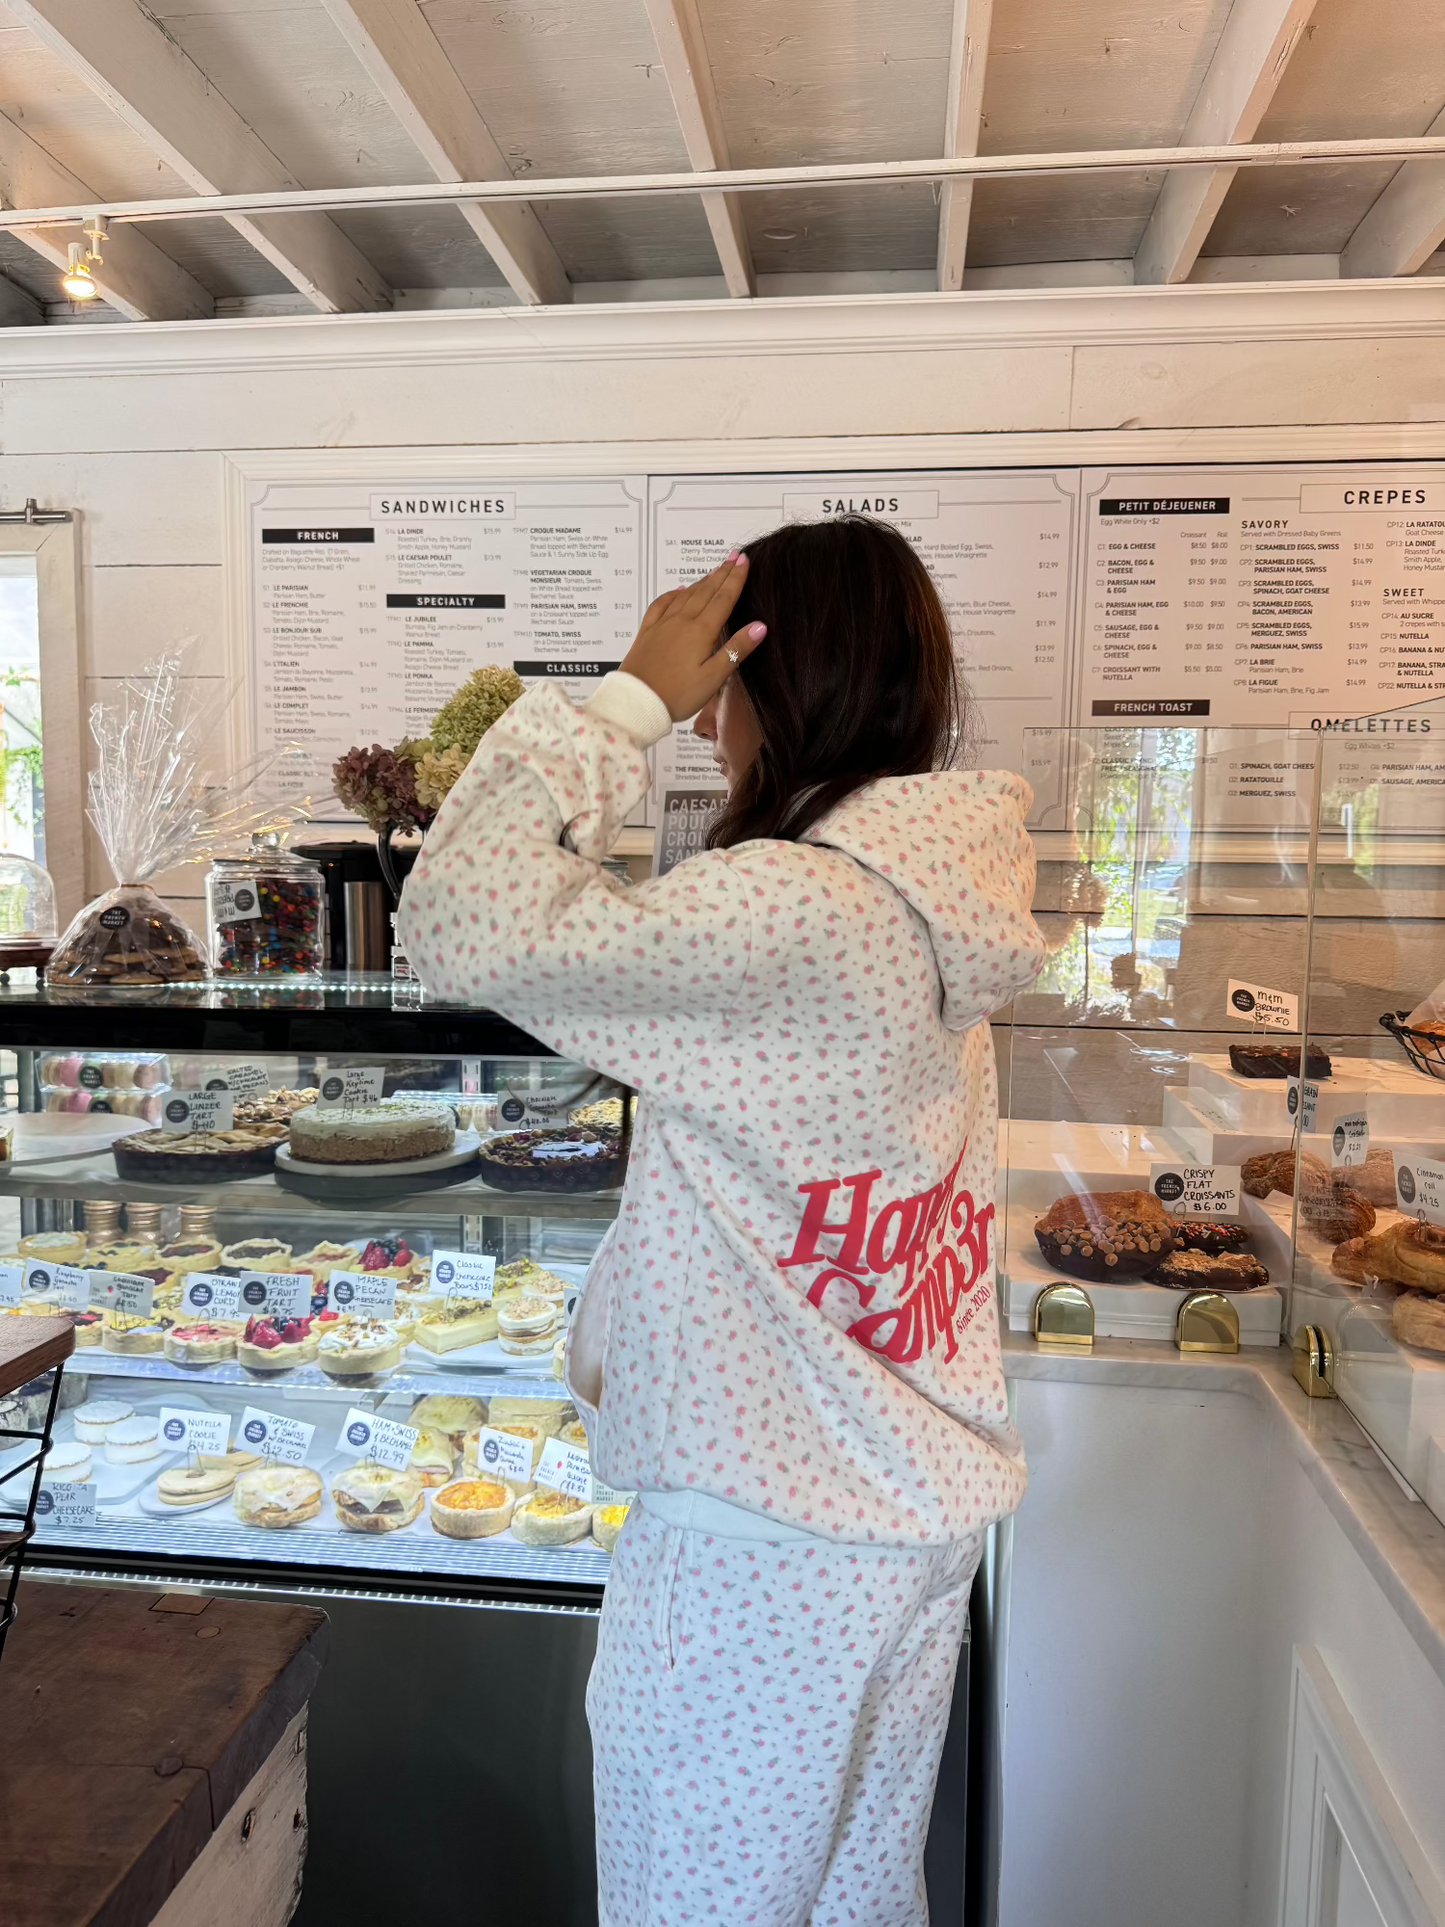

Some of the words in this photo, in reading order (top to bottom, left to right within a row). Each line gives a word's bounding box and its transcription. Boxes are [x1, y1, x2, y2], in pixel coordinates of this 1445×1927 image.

[1344, 490, 1426, 505] CREPES
[381, 500, 505, 514] SANDWICHES
[822, 497, 899, 514] SALADS
[1118, 502, 1149, 511] PETIT
[1153, 500, 1216, 511] DÉJEUENER
[1241, 520, 1289, 529] SAVORY
[296, 531, 339, 540] FRENCH
[1296, 543, 1317, 551] EGGS,
[1108, 559, 1133, 567] BACON,
[1296, 558, 1315, 566] EGGS,
[1286, 566, 1304, 574] HAM,
[1295, 580, 1314, 588] EGGS,
[1383, 588, 1425, 597] SWEET
[416, 597, 476, 606] SPECIALTY
[1137, 601, 1154, 609] HAM,
[1105, 624, 1139, 632] SAUSAGE,
[1293, 622, 1312, 630] EGGS,
[1251, 630, 1284, 638] MERGUEZ,
[1104, 644, 1136, 652] SPINACH,
[1282, 643, 1300, 651] HAM,
[546, 664, 600, 673] CLASSICS
[1397, 662, 1428, 670] BANANA,
[1114, 703, 1156, 712] FRENCH
[1159, 702, 1193, 712] TOAST
[1310, 718, 1431, 733] OMELETTES
[1239, 790, 1273, 798] MERGUEZ,
[1254, 1002, 1290, 1016] BROWNIE
[346, 1070, 365, 1080] Large
[188, 1091, 217, 1101] LARGE
[189, 1102, 222, 1111] LINZER
[190, 1112, 213, 1120] TART
[1183, 1168, 1215, 1180] CRISPY
[1416, 1167, 1445, 1181] Cinnamon
[1186, 1180, 1213, 1189] FLAT
[1183, 1189, 1236, 1201] CROISSANTS
[1419, 1192, 1440, 1208] $4.25
[266, 1276, 301, 1287] FRESH
[356, 1276, 388, 1287] MAPLE
[267, 1287, 298, 1298] FRUIT
[355, 1284, 386, 1295] PECAN
[214, 1297, 235, 1305] CURD
[265, 1298, 294, 1307] TART
[956, 1306, 974, 1335] Since
[973, 1284, 992, 1313] 2020
[188, 1418, 222, 1428] NUTELLA
[267, 1415, 299, 1428] TOMATO
[281, 1429, 305, 1441] SWISS
[370, 1445, 405, 1464] $12.99
[54, 1492, 76, 1502] PEAR
[52, 1505, 96, 1516] CHEESECAKE
